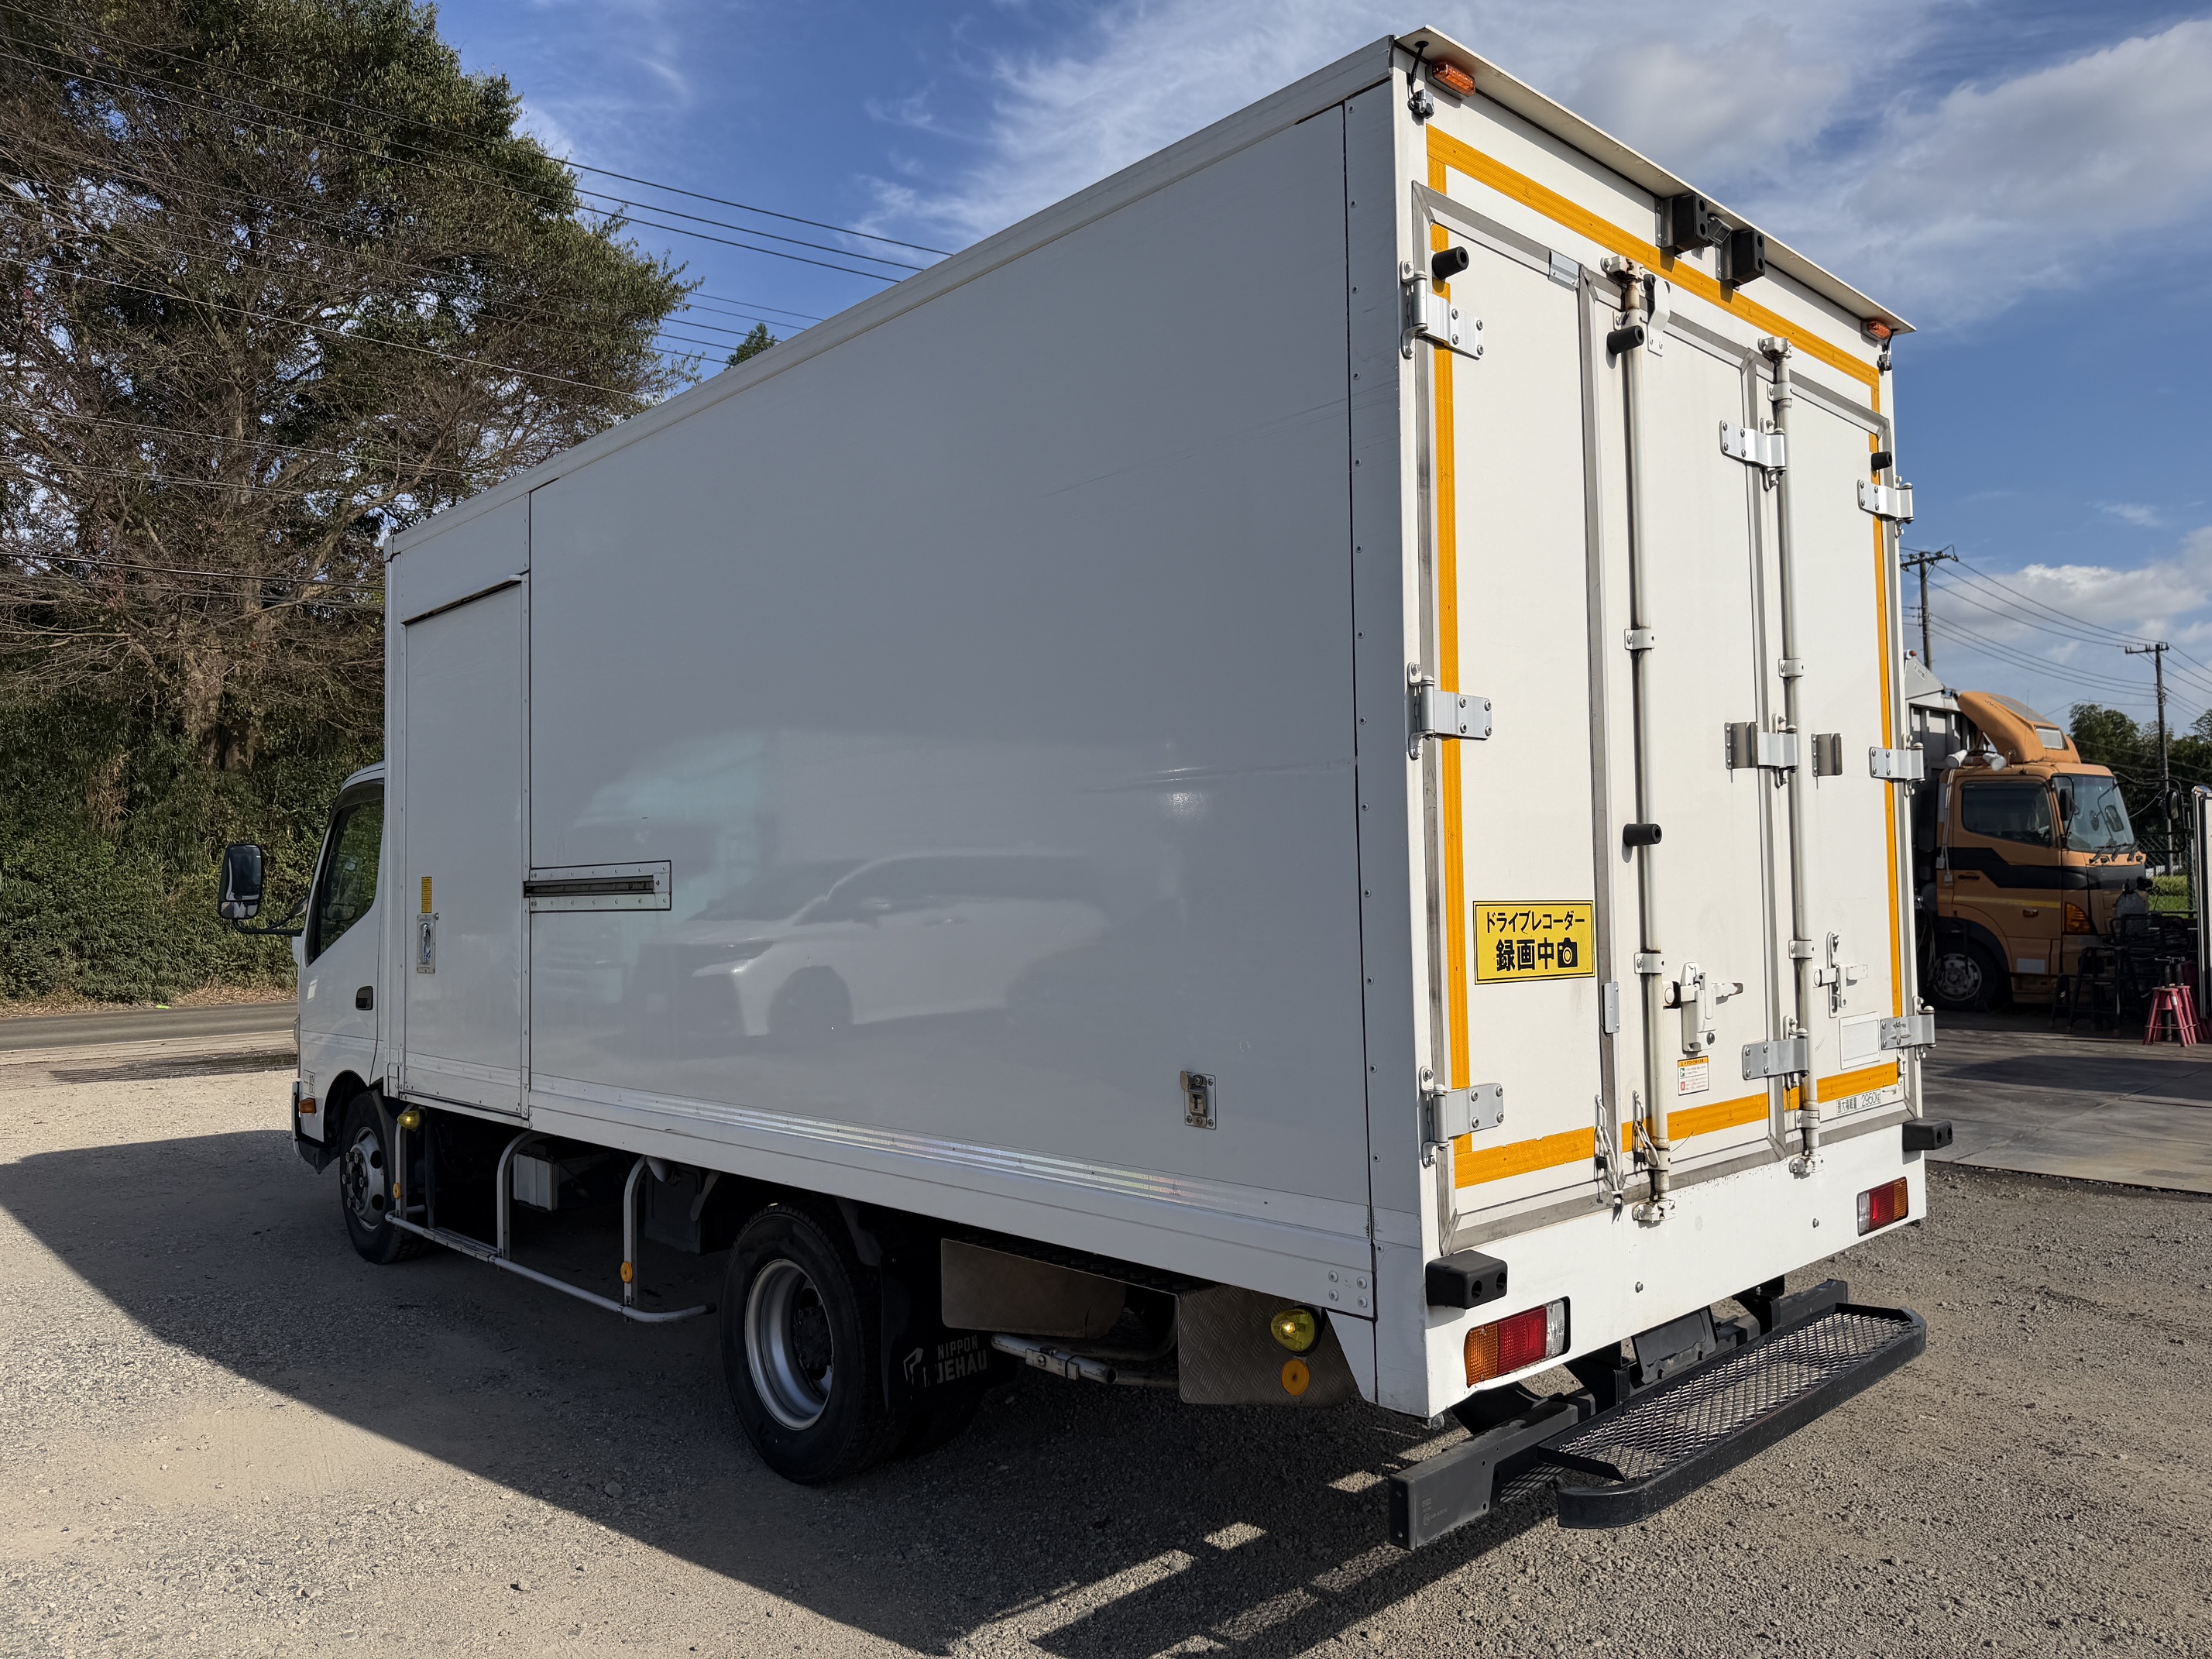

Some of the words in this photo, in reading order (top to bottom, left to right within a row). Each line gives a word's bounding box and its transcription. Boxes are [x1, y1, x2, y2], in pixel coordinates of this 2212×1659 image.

[1486, 910, 1585, 933] ドライブレコーダー
[1496, 936, 1554, 972] 録画中
[937, 1334, 978, 1360] NIPPON
